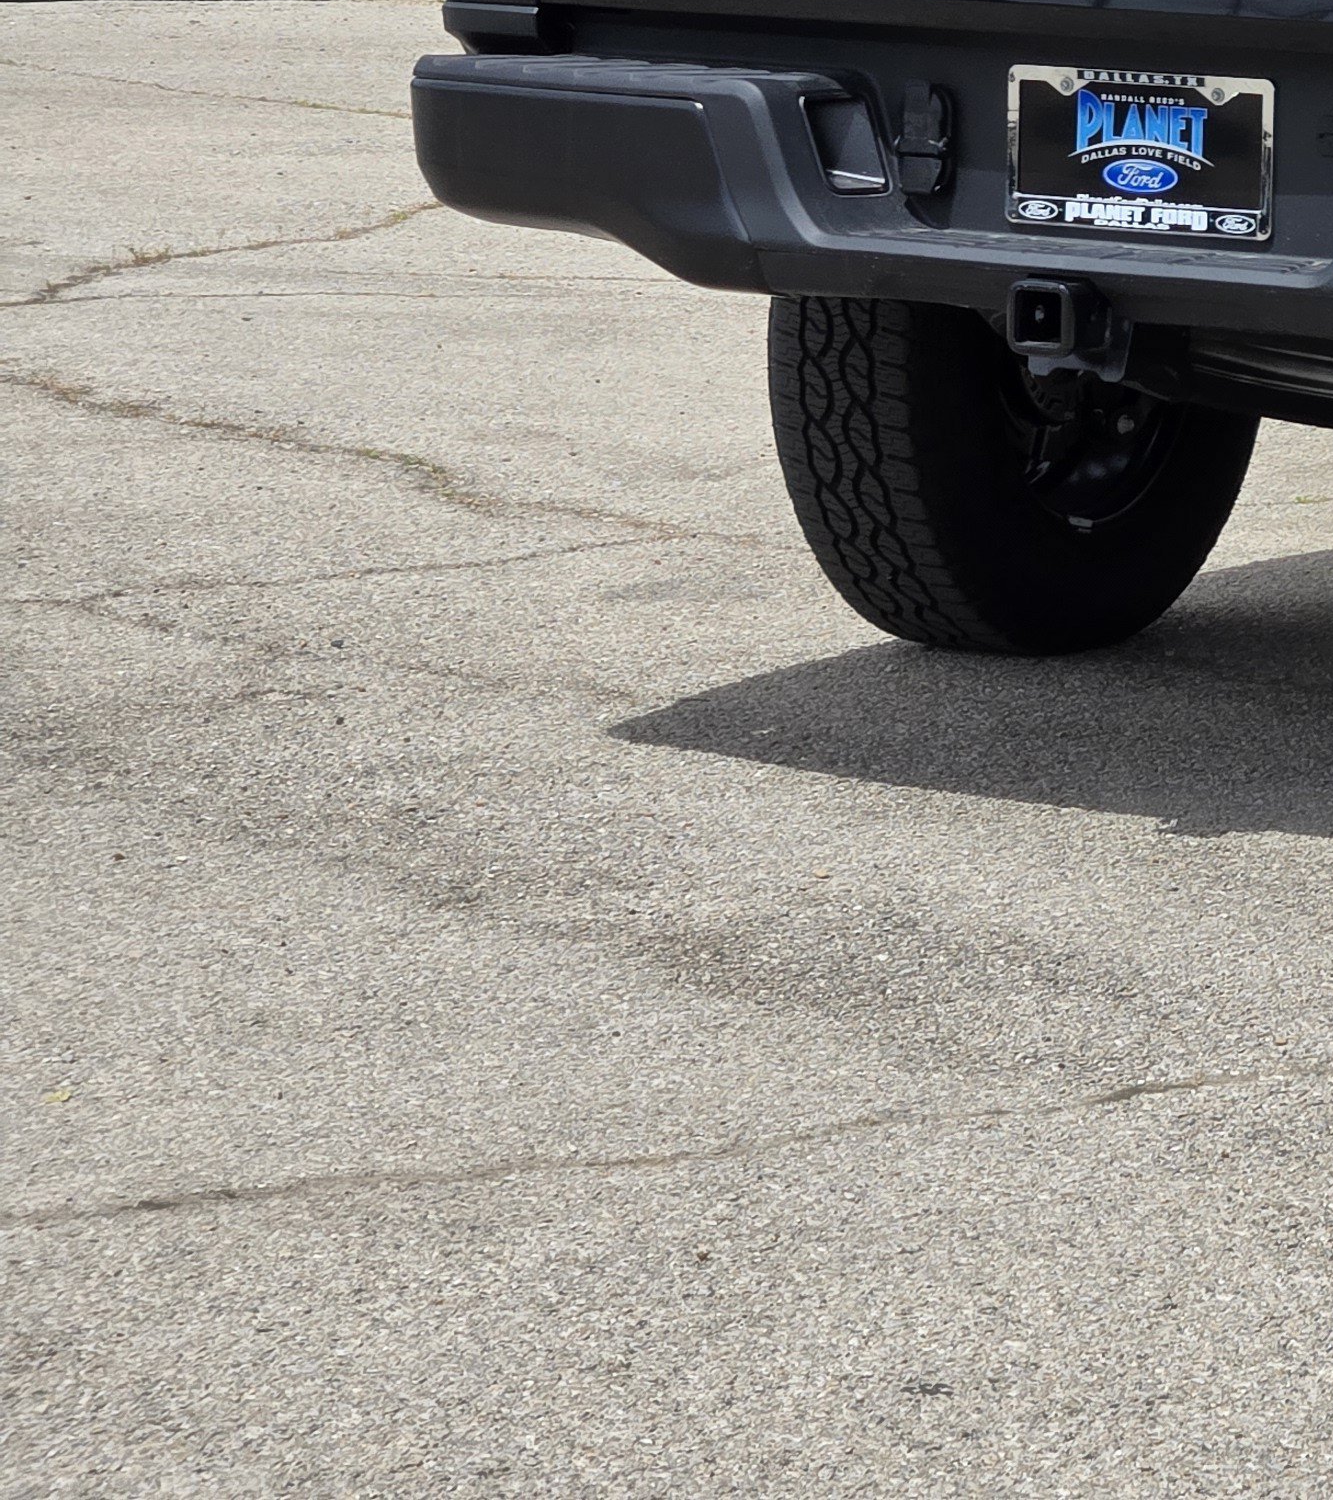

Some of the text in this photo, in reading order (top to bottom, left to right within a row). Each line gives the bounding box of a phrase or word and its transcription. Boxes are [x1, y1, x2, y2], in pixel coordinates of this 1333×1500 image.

[1076, 89, 1208, 158] PLANET
[1081, 147, 1201, 171] DALLAS LOVE FIELD
[1117, 163, 1165, 189] Ford
[1065, 201, 1146, 222] PLANET
[1151, 207, 1208, 231] FORD
[1094, 218, 1170, 231] DALLAS
